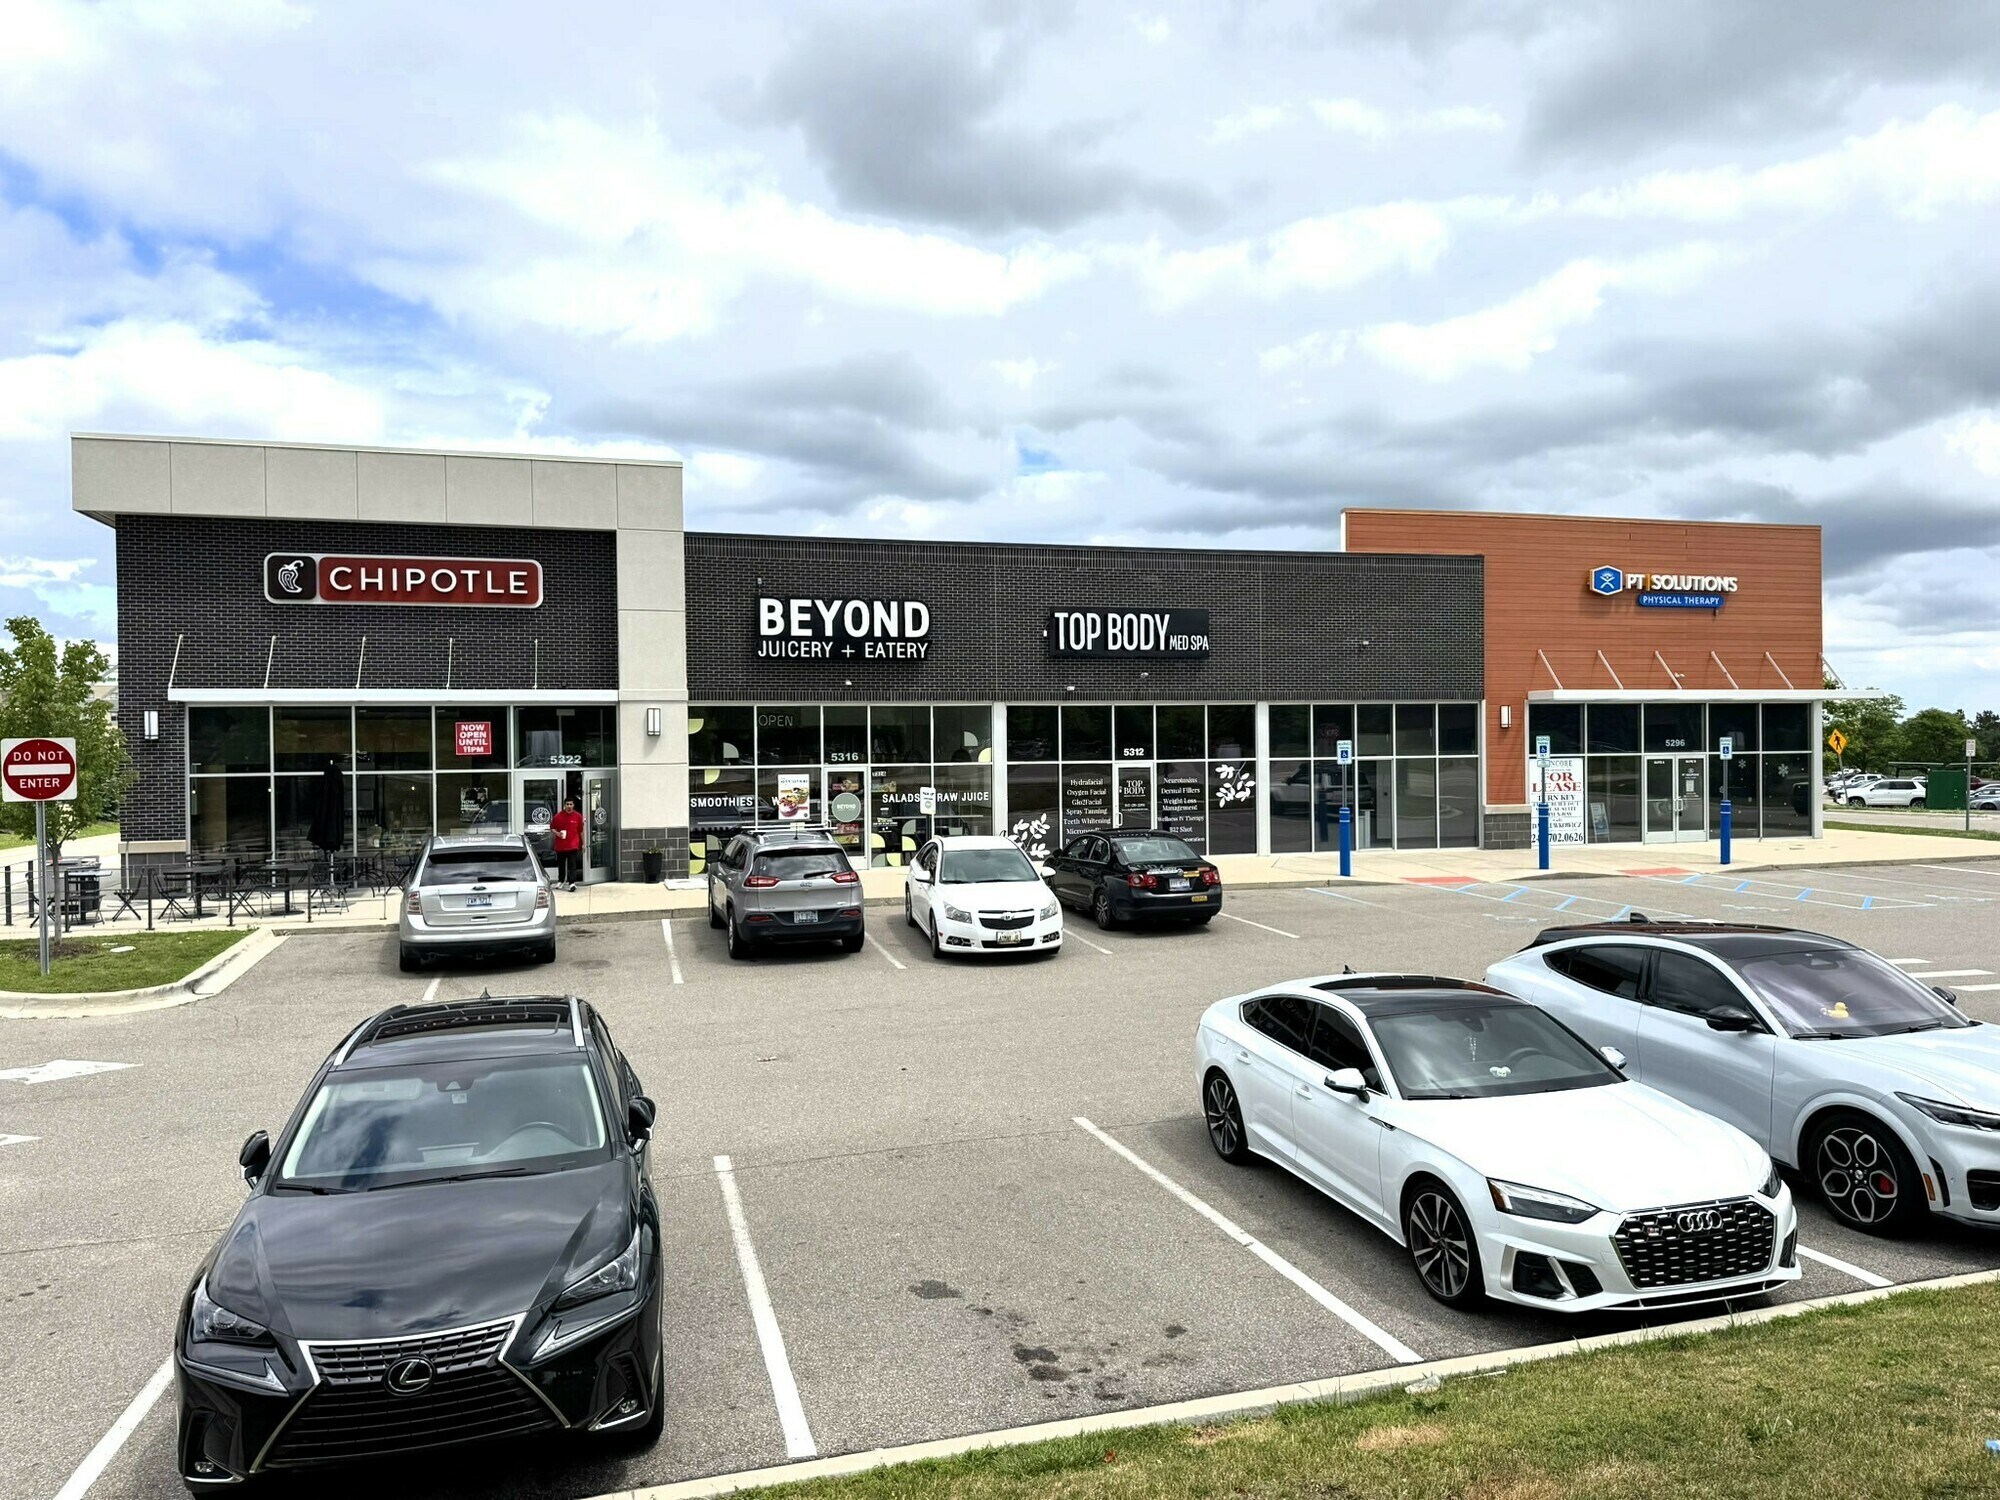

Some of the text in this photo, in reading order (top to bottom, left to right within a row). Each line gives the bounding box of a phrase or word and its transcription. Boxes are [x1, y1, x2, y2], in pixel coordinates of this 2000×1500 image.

[329, 566, 528, 595] CHIPOTLE
[1626, 574, 1738, 592] PT SOLUTIONS
[1643, 595, 1720, 605] PHYSICAL THERAPY
[759, 598, 930, 638] BEYOND
[1054, 612, 1209, 651] TOP BODY MED SPA
[758, 640, 833, 658] JUICERY
[864, 642, 929, 659] EATERY
[758, 714, 793, 727] OPEN
[461, 724, 485, 732] NOW
[459, 731, 487, 739] OPEN
[459, 738, 488, 746] UNTIL
[1665, 739, 1686, 747] 5296
[13, 750, 64, 762] DO NOT
[831, 752, 859, 762] 5316
[1123, 748, 1144, 757] 5312
[550, 754, 582, 765] 5322
[19, 778, 60, 789] ENTER
[1070, 778, 1104, 787] Hydrafacial
[1532, 782, 1582, 793] LEASE
[1123, 787, 1146, 795] BODY
[690, 796, 754, 808] SMOOTHIES
[882, 791, 989, 804] SALADS RAW JUICE
[1081, 817, 1111, 825] Whitening
[1531, 833, 1584, 843] 2702.0626
